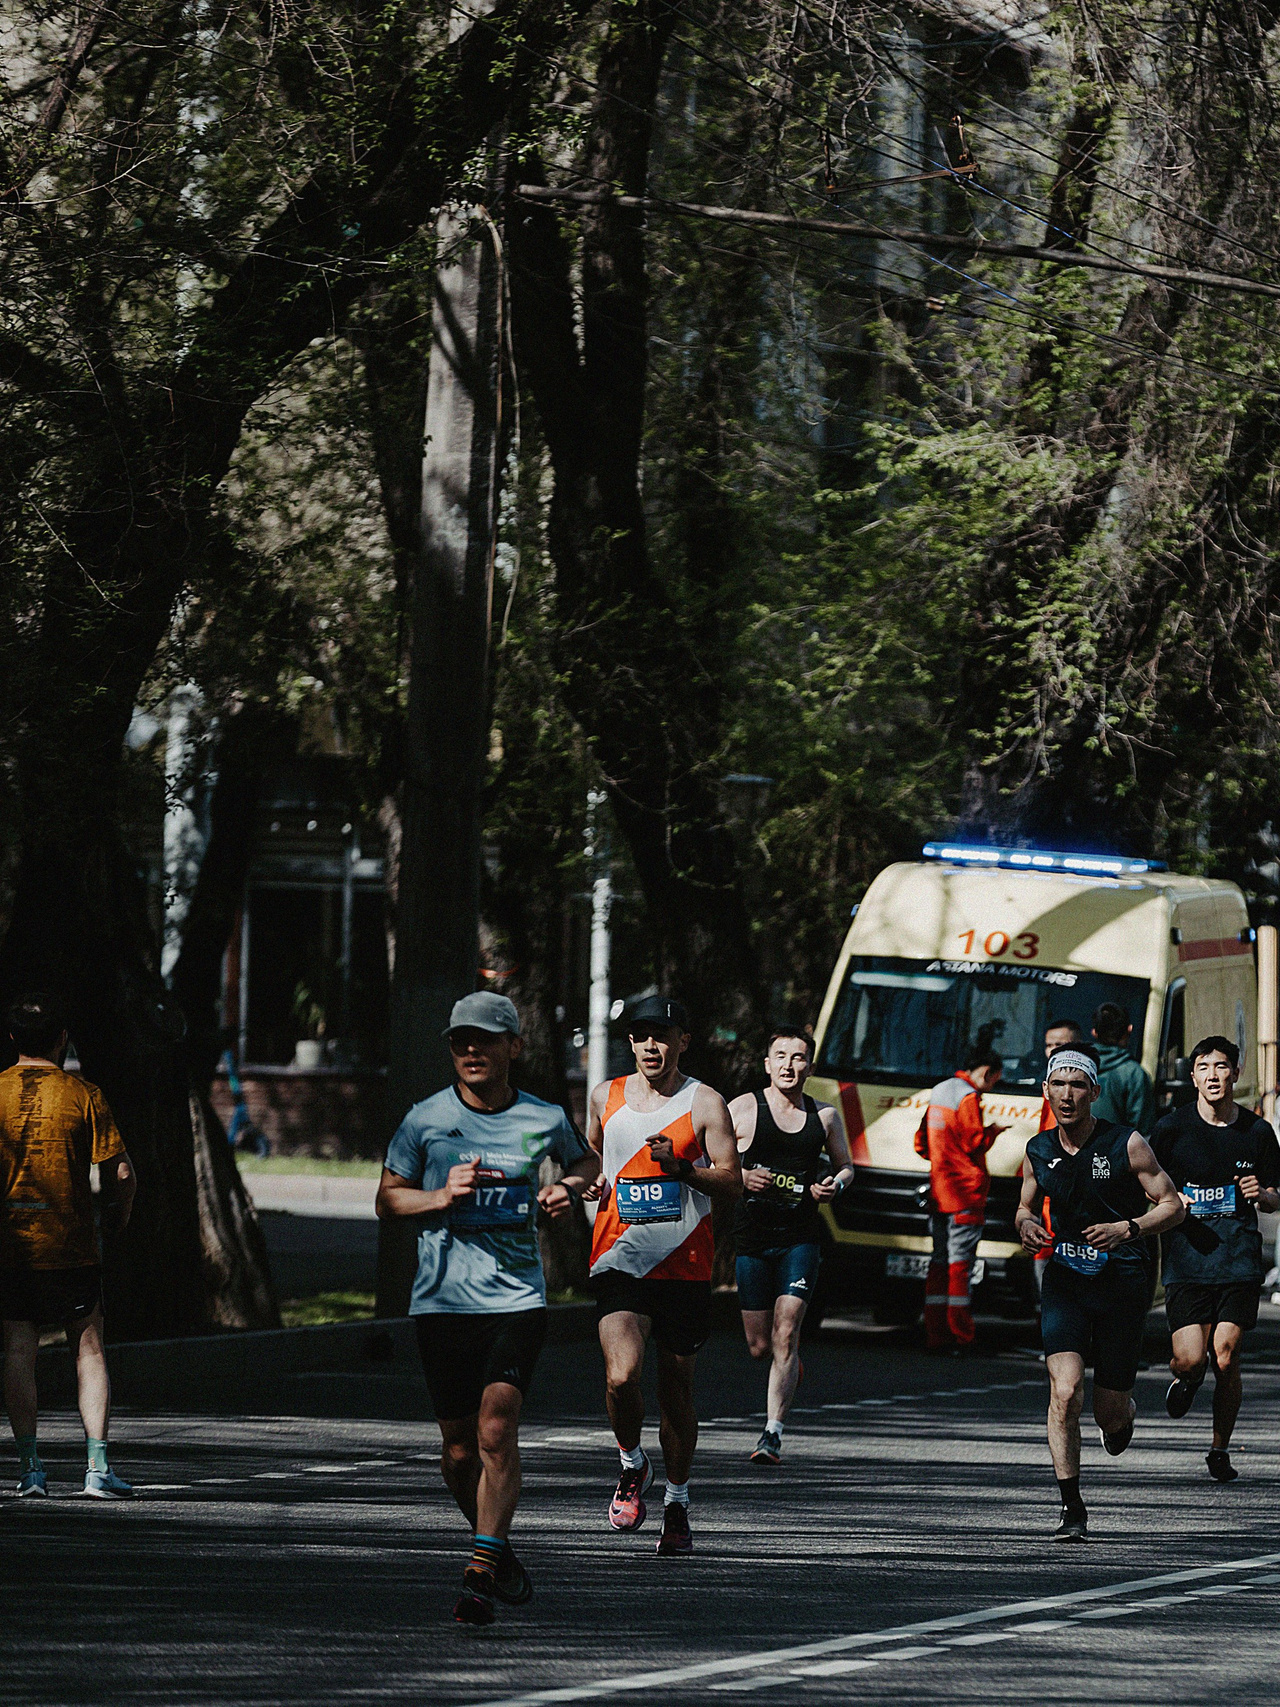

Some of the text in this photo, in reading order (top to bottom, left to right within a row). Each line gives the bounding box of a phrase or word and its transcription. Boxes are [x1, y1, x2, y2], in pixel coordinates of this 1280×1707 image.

[958, 929, 1040, 960] 103
[925, 960, 1078, 987] ASTANA MOTORS
[1092, 1168, 1110, 1176] ERG
[629, 1183, 663, 1202] 919
[1192, 1186, 1225, 1202] 1188
[1061, 1242, 1098, 1261] 1549
